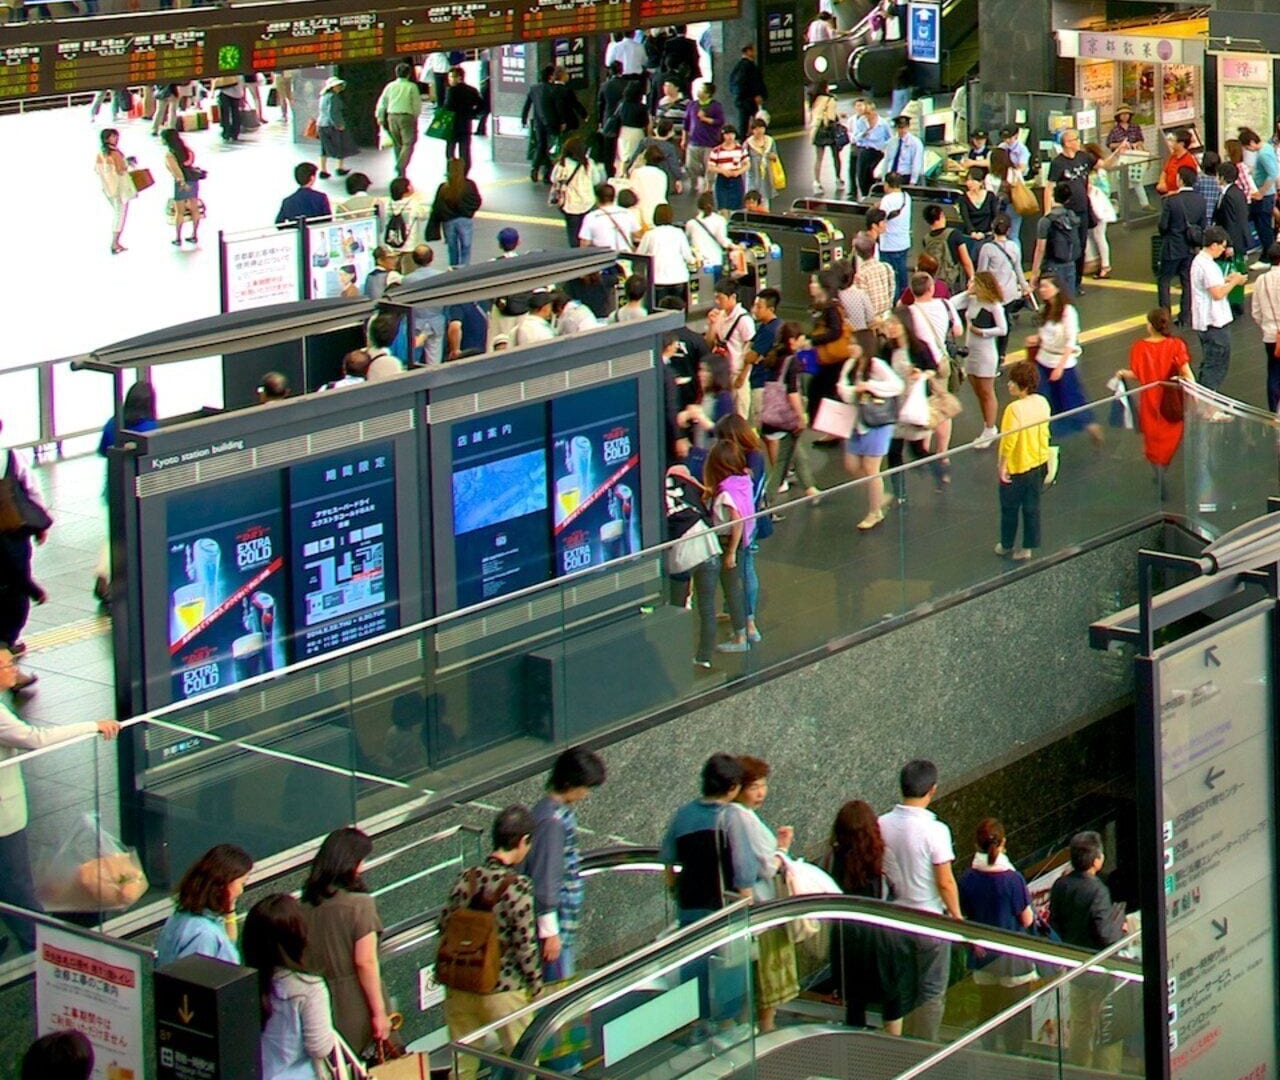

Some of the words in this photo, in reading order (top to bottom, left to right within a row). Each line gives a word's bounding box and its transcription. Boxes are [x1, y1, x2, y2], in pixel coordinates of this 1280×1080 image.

[457, 423, 513, 448] 店舗案内
[603, 436, 631, 450] EXTRA
[152, 456, 179, 469] Kyoto
[181, 449, 210, 461] station
[211, 440, 244, 454] building
[603, 444, 631, 462] COLD
[325, 456, 386, 482] 期間限定
[237, 536, 272, 554] EXTRA
[563, 544, 591, 560] EXTRA
[237, 547, 272, 566] COLD
[564, 553, 591, 571] COLD
[183, 663, 219, 682] EXTRA
[184, 673, 219, 694] COLD
